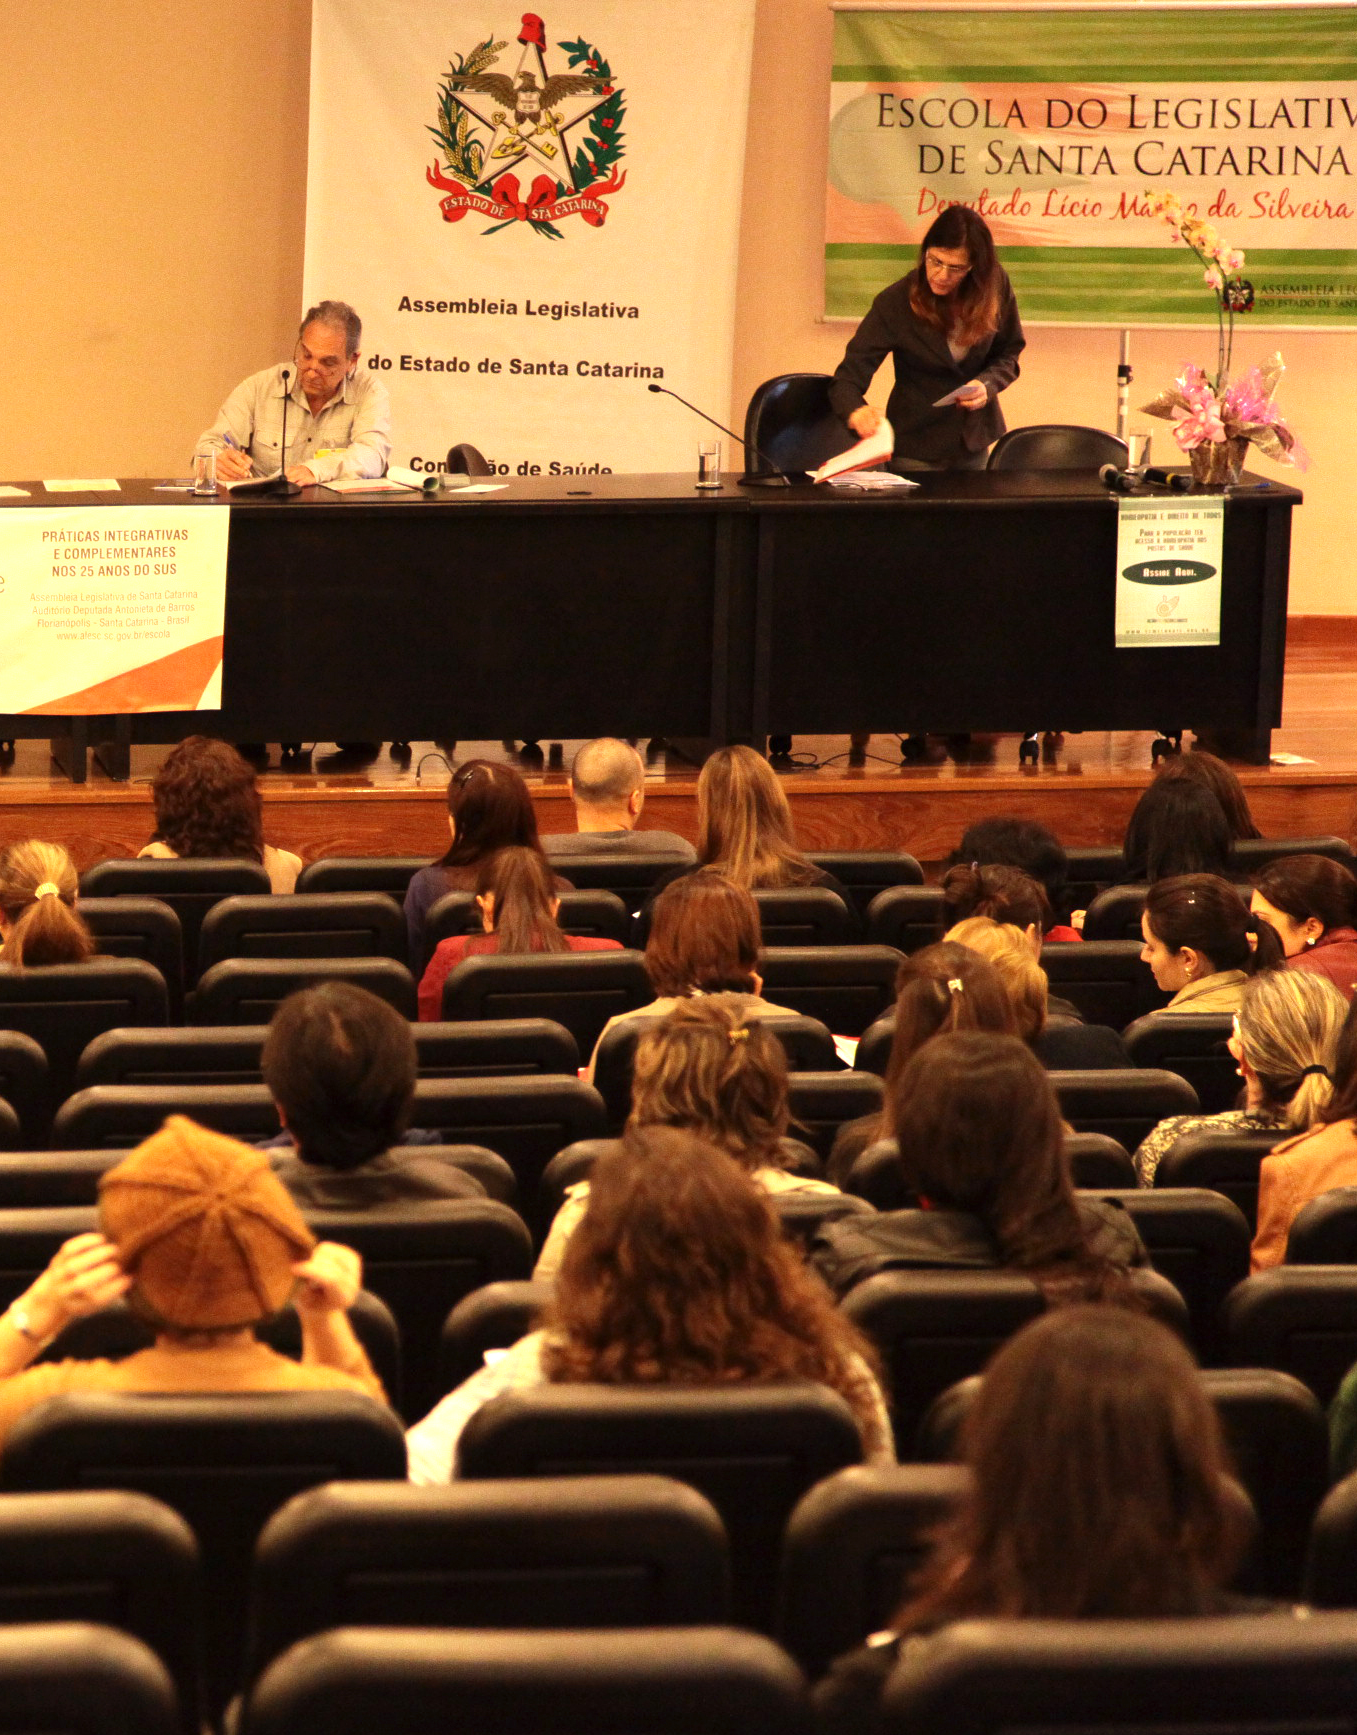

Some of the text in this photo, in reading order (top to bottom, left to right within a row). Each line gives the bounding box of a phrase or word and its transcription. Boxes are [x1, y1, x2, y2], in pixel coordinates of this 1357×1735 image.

[877, 93, 1357, 129] ESCOLA DO LEGISLATIV
[917, 139, 1353, 176] DE SANTA CATARINA
[443, 196, 605, 219] ESTADO DE STA CATARINA
[1041, 187, 1102, 217] Lício
[1109, 191, 1198, 219] Mao
[1208, 188, 1242, 218] da
[1248, 187, 1354, 219] Silveira
[398, 295, 640, 321] Assembleia Legislativa
[368, 354, 665, 380] do Estado de Santa Catarina
[516, 461, 541, 476] de
[548, 461, 613, 475] Saúde
[42, 528, 189, 543] PRÁTICAS INTEGRATIVAS
[53, 546, 176, 560] E COMPLEMENTARES
[52, 563, 177, 577] NOS 25 ANOS DO SUS
[30, 589, 198, 603] Assembleia Legislativa de Santa Catarina
[32, 603, 195, 616] Auditório Deputada Antonieta de Barros
[37, 617, 91, 629] Florianópolis
[99, 617, 123, 628] Santa
[125, 616, 159, 627] Catarina
[167, 615, 190, 626] Brasil
